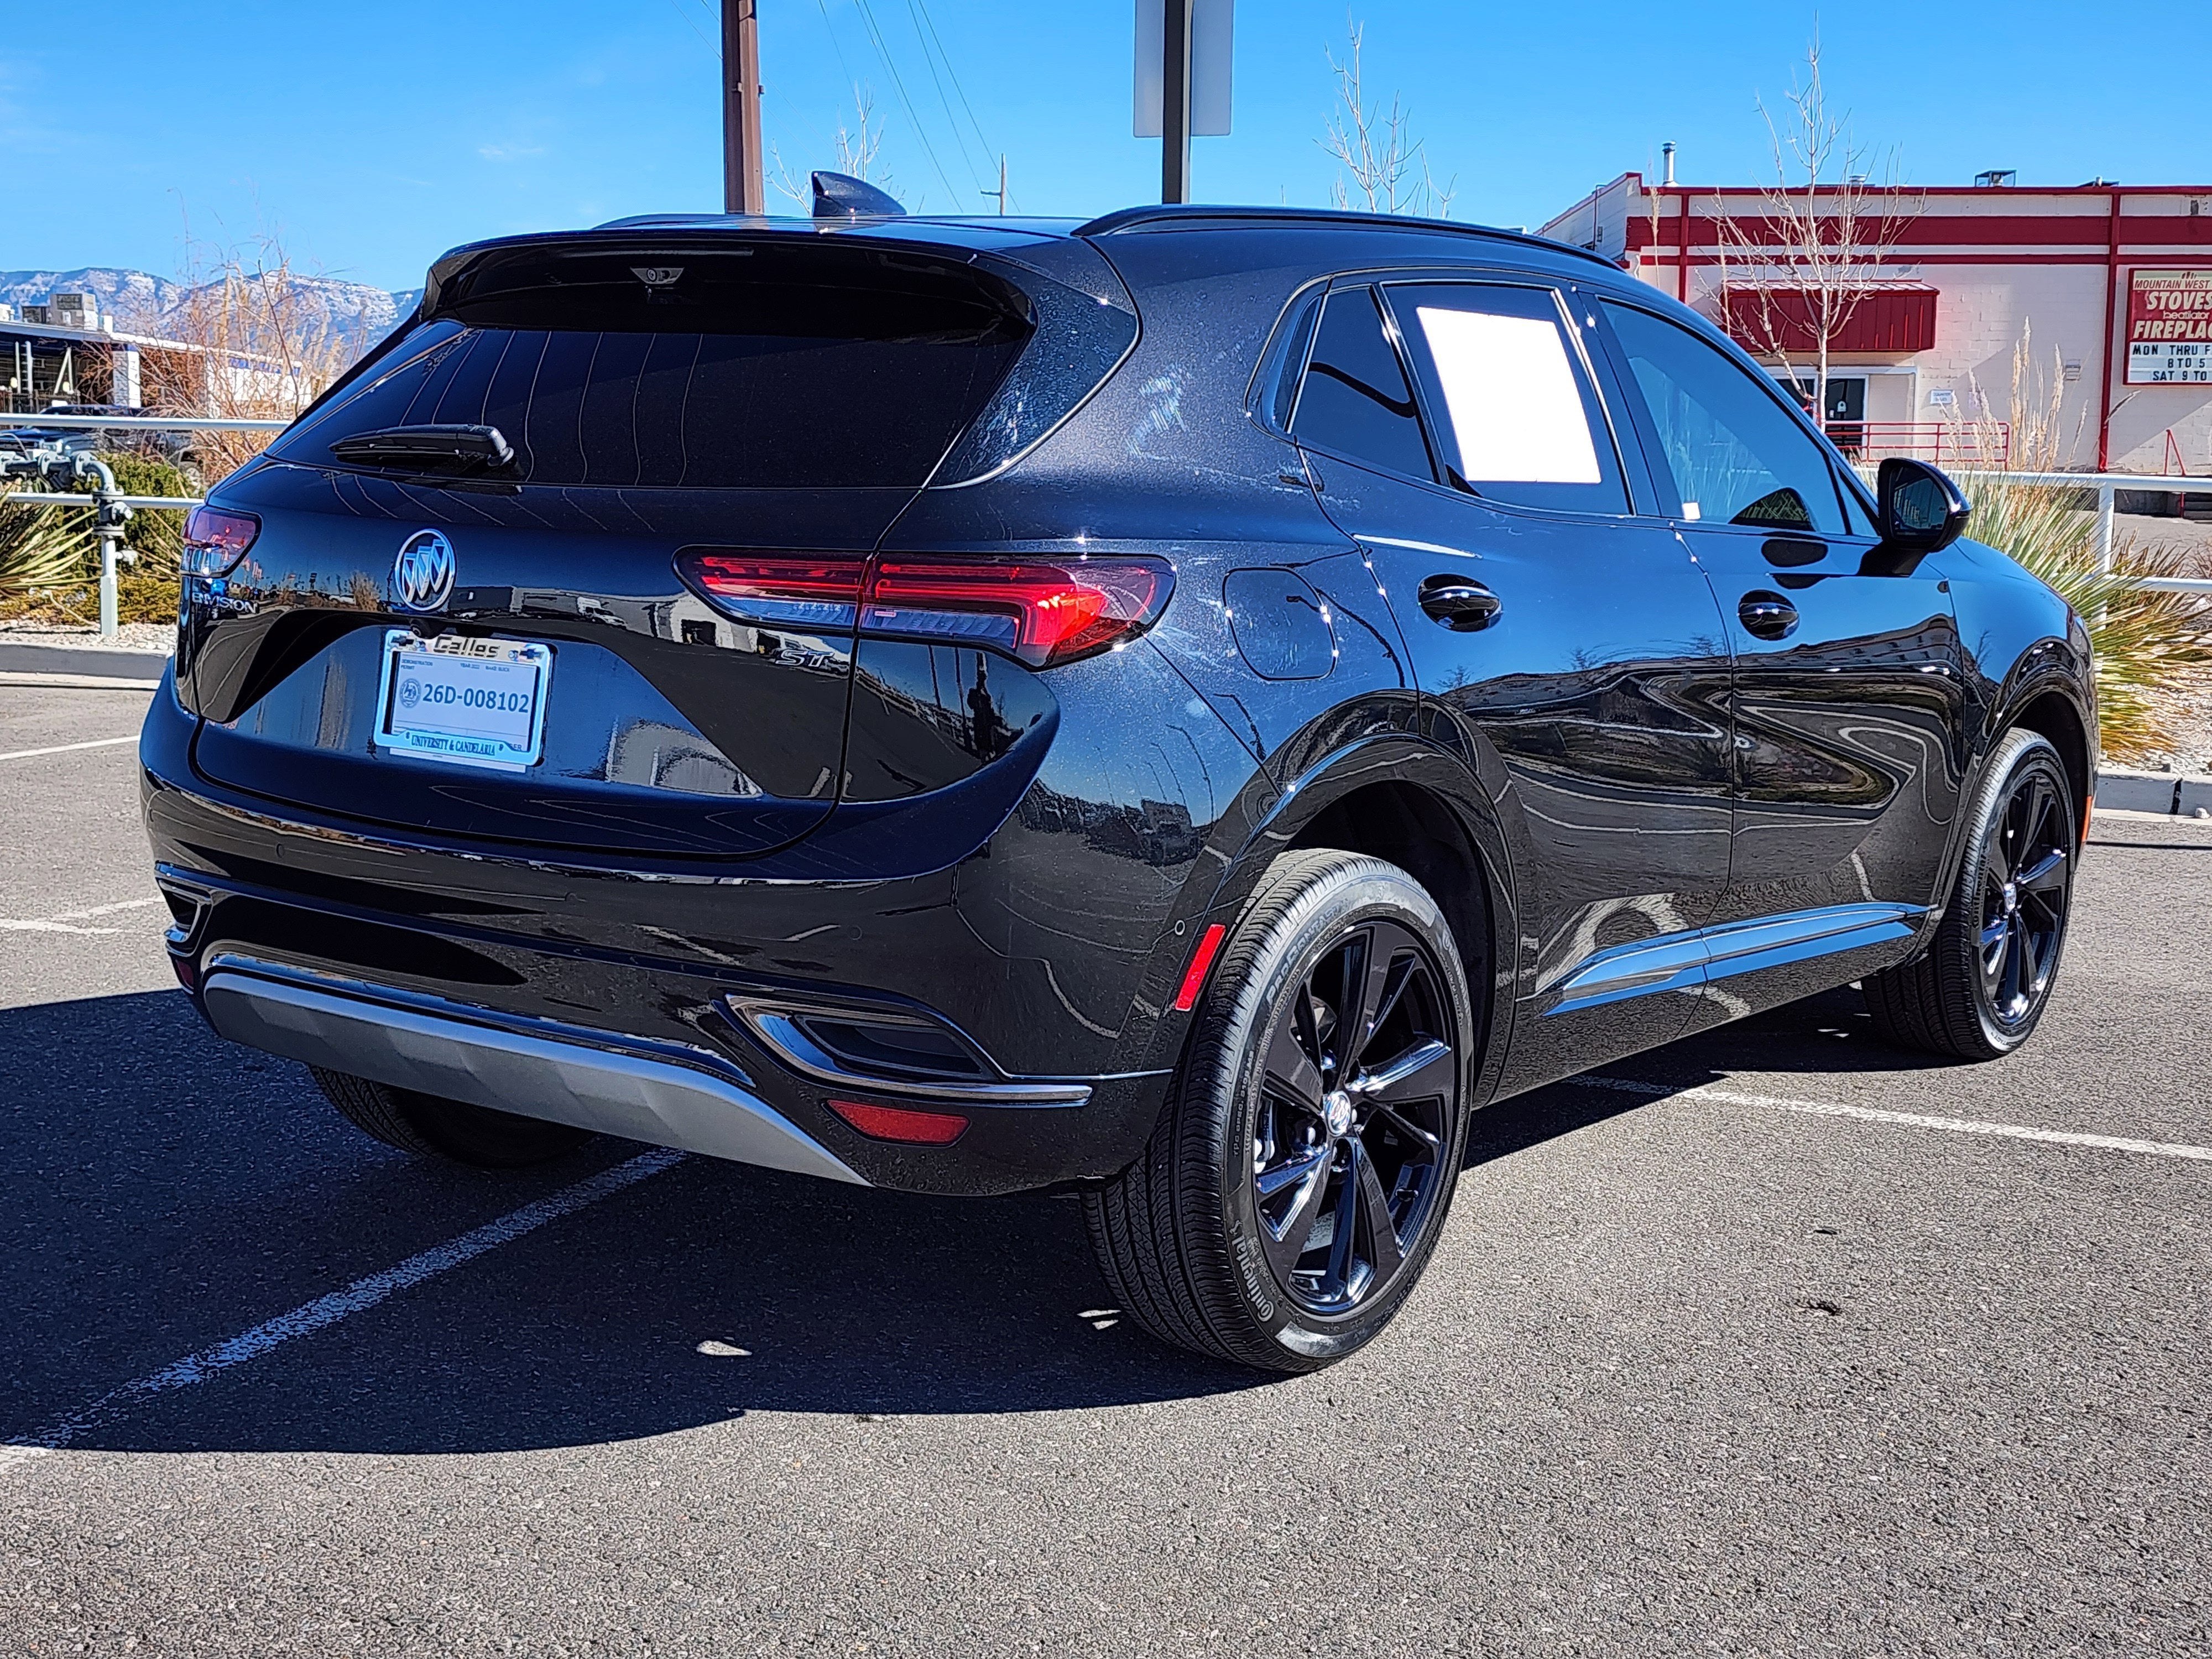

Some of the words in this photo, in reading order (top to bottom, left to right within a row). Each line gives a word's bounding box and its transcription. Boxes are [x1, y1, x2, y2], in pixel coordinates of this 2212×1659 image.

[2135, 280, 2182, 289] MOUNTAIN
[2185, 280, 2210, 289] WEST
[2146, 291, 2212, 310] STOVES
[2132, 345, 2158, 355] MON
[2169, 345, 2198, 355] THRU
[2168, 358, 2174, 368] 8
[2177, 358, 2192, 368] TO
[2199, 358, 2205, 368] 5
[2153, 371, 2174, 380] SAT
[2182, 371, 2188, 380] 9
[2194, 371, 2207, 380] TO
[192, 592, 258, 614] ENVISION
[434, 636, 500, 658] Galles
[775, 649, 835, 667] ST
[422, 684, 529, 713] 26D-008102
[411, 735, 448, 750] UNIVERSITY
[450, 739, 455, 750] &
[455, 740, 495, 756] CANDELARIA
[1232, 1236, 1274, 1322] Continental
